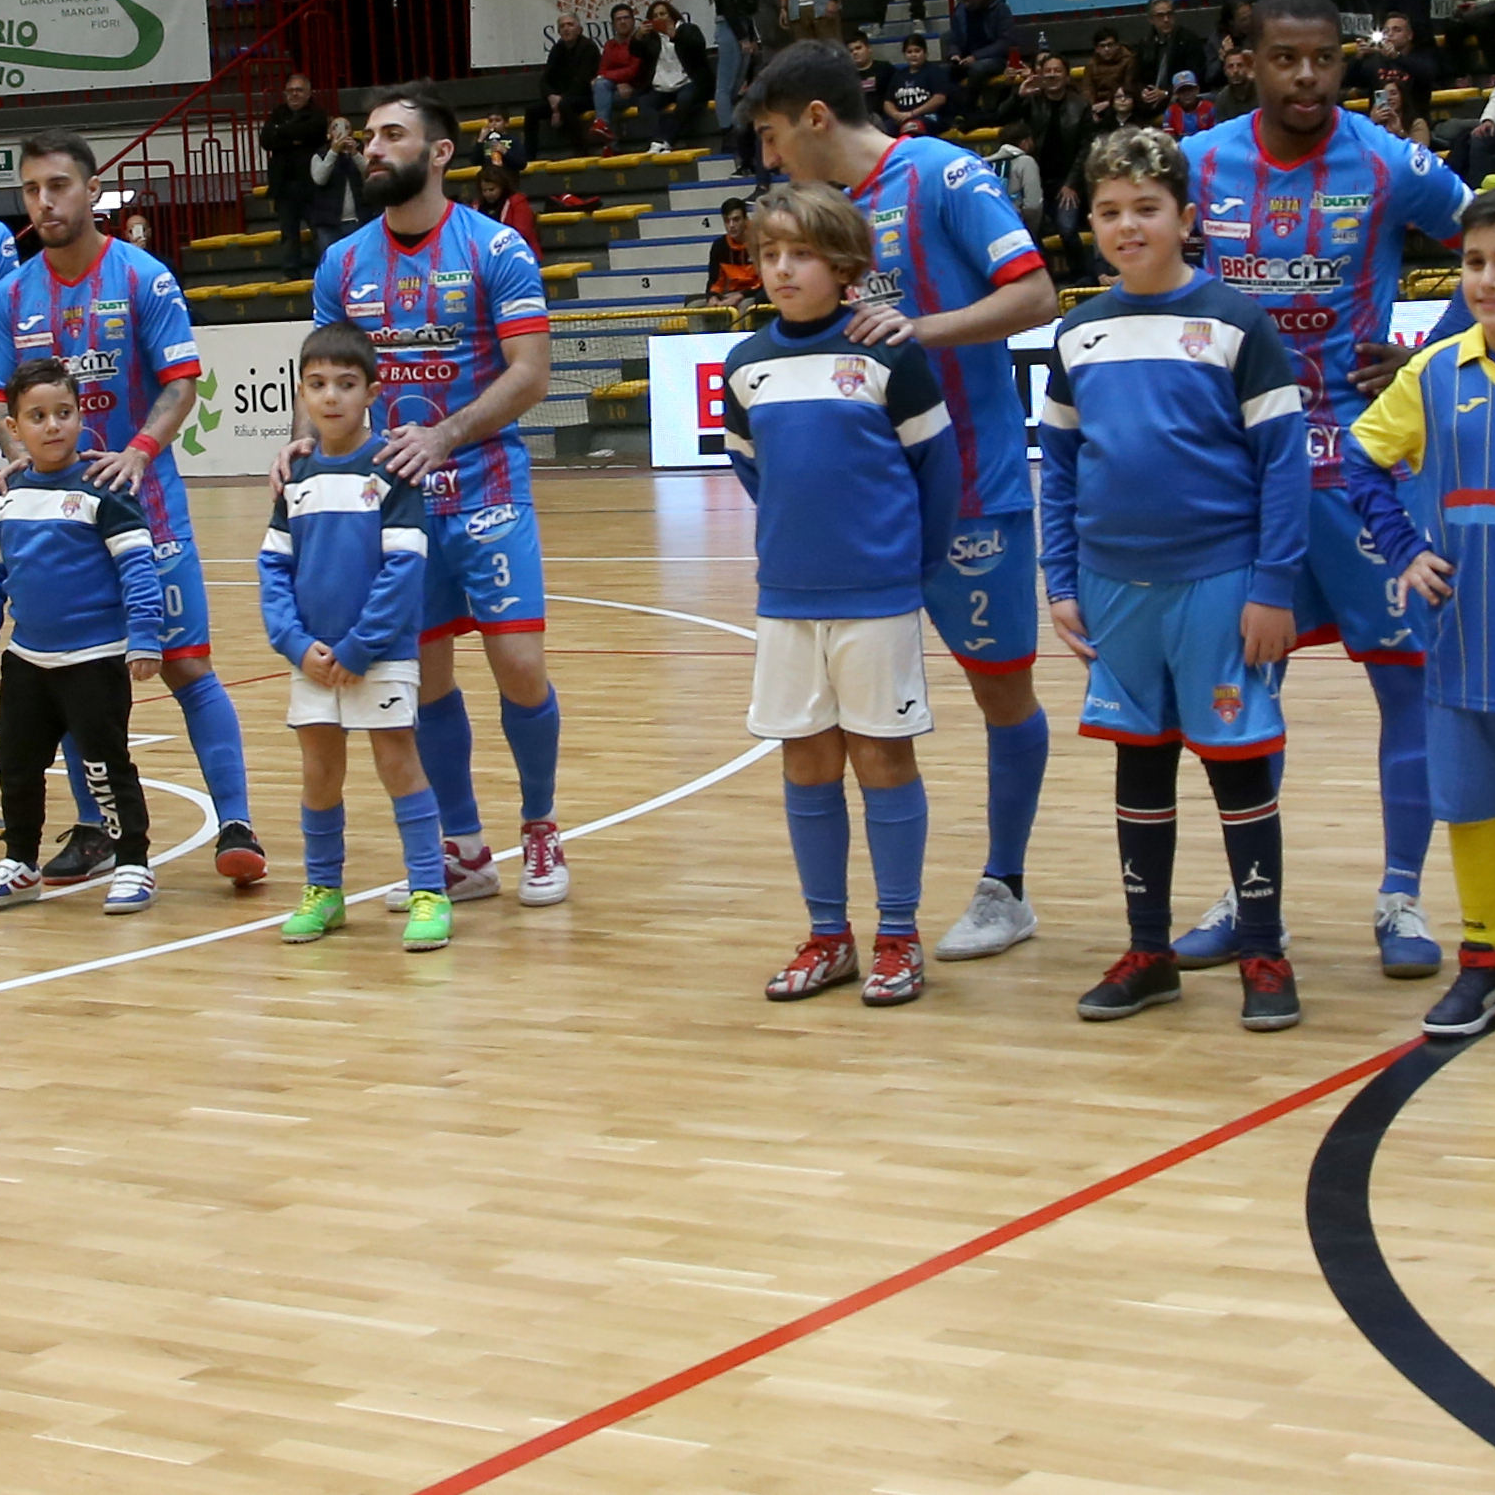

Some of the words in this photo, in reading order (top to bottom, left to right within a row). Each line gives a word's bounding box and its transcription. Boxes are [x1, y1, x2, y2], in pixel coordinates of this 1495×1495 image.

[61, 6, 110, 17] MANGIMI
[91, 19, 120, 29] FIORI
[1270, 198, 1300, 211] META
[1323, 196, 1368, 207] DUSTY
[702, 217, 710, 228] 4
[437, 273, 472, 283] DUSTY
[642, 278, 650, 288] 3
[578, 341, 586, 352] 2
[391, 365, 451, 381] BACCO
[234, 425, 258, 437] Rifiuti
[492, 553, 510, 587] 3
[1385, 578, 1404, 618] 9
[969, 590, 988, 627] 2
